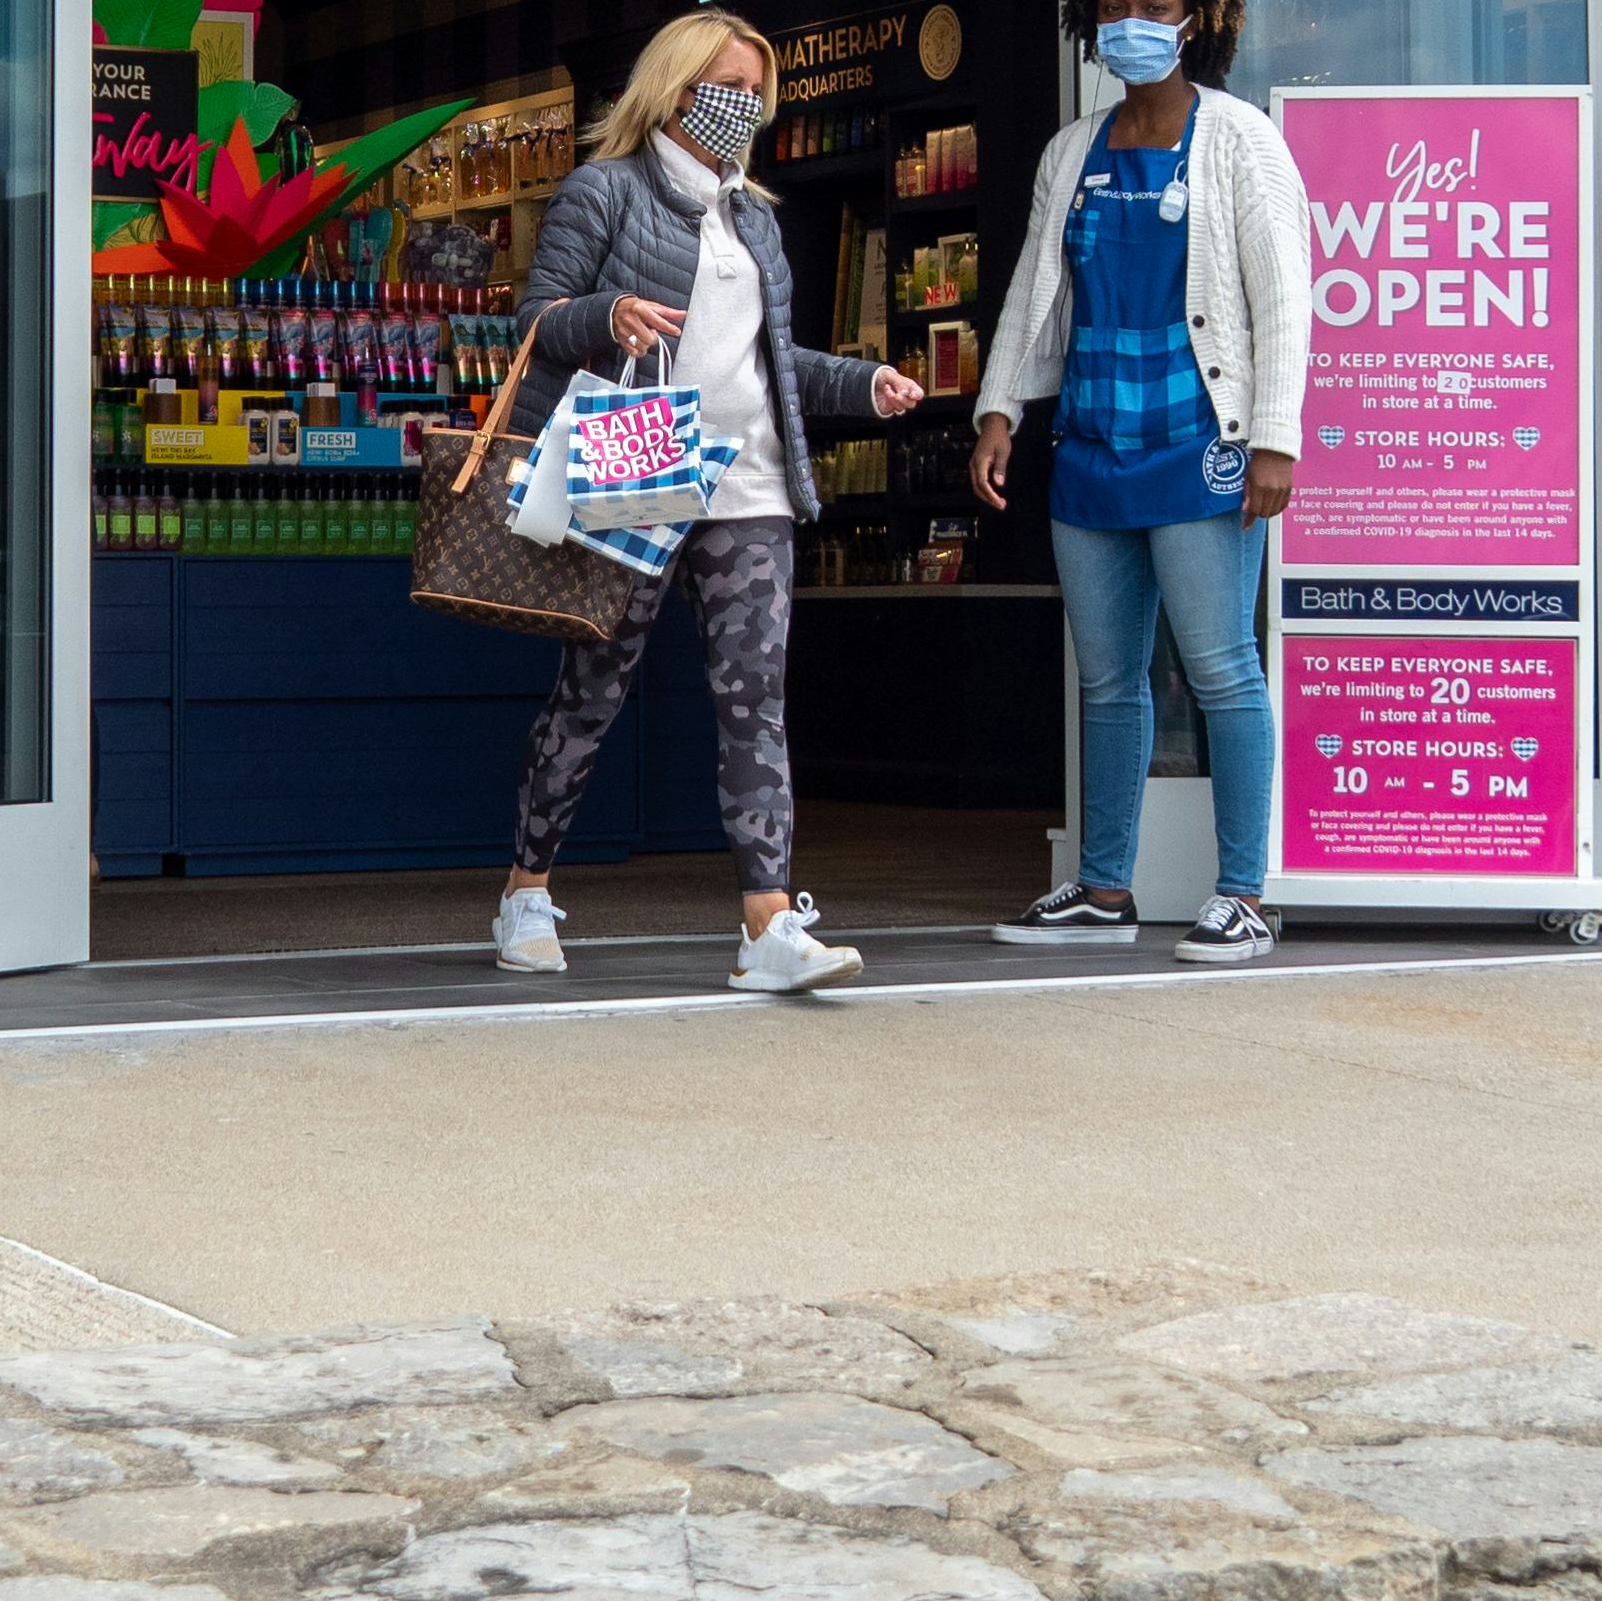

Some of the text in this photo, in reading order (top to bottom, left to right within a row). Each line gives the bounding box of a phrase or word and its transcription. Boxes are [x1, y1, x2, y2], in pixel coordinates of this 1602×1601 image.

[775, 14, 907, 73] MATHERAPY
[94, 63, 145, 80] YOUR
[93, 84, 150, 100] RANCE
[780, 64, 873, 102] ADQUARTERS
[1386, 129, 1479, 203] Yes!
[1310, 201, 1550, 259] WE'RE
[1311, 268, 1550, 328] OPEN!
[1308, 354, 1554, 370] TO KEEP EVERYONE SAFE,
[1314, 374, 1353, 387] we're
[1359, 374, 1417, 391] limiting
[1422, 376, 1437, 388] to
[1471, 375, 1547, 389] customers
[1363, 394, 1497, 409] in store at a time.
[586, 402, 664, 440] BATH
[154, 431, 202, 443] SWEET
[310, 434, 352, 446] FRESH
[1355, 431, 1505, 447] STORE HOURS:
[585, 437, 686, 483] WORKS
[1377, 454, 1486, 469] 10 AM 5 PM
[1364, 527, 1411, 536] COVID-19
[1302, 587, 1562, 615] Bath & Body Works
[1303, 657, 1553, 676] TO KEEP EVERYONE SAFE,
[1300, 678, 1556, 704] we're limiting to 20 customers
[1353, 740, 1503, 757] STORE HOURS:
[1333, 766, 1527, 797] 10 AM 5 PM
